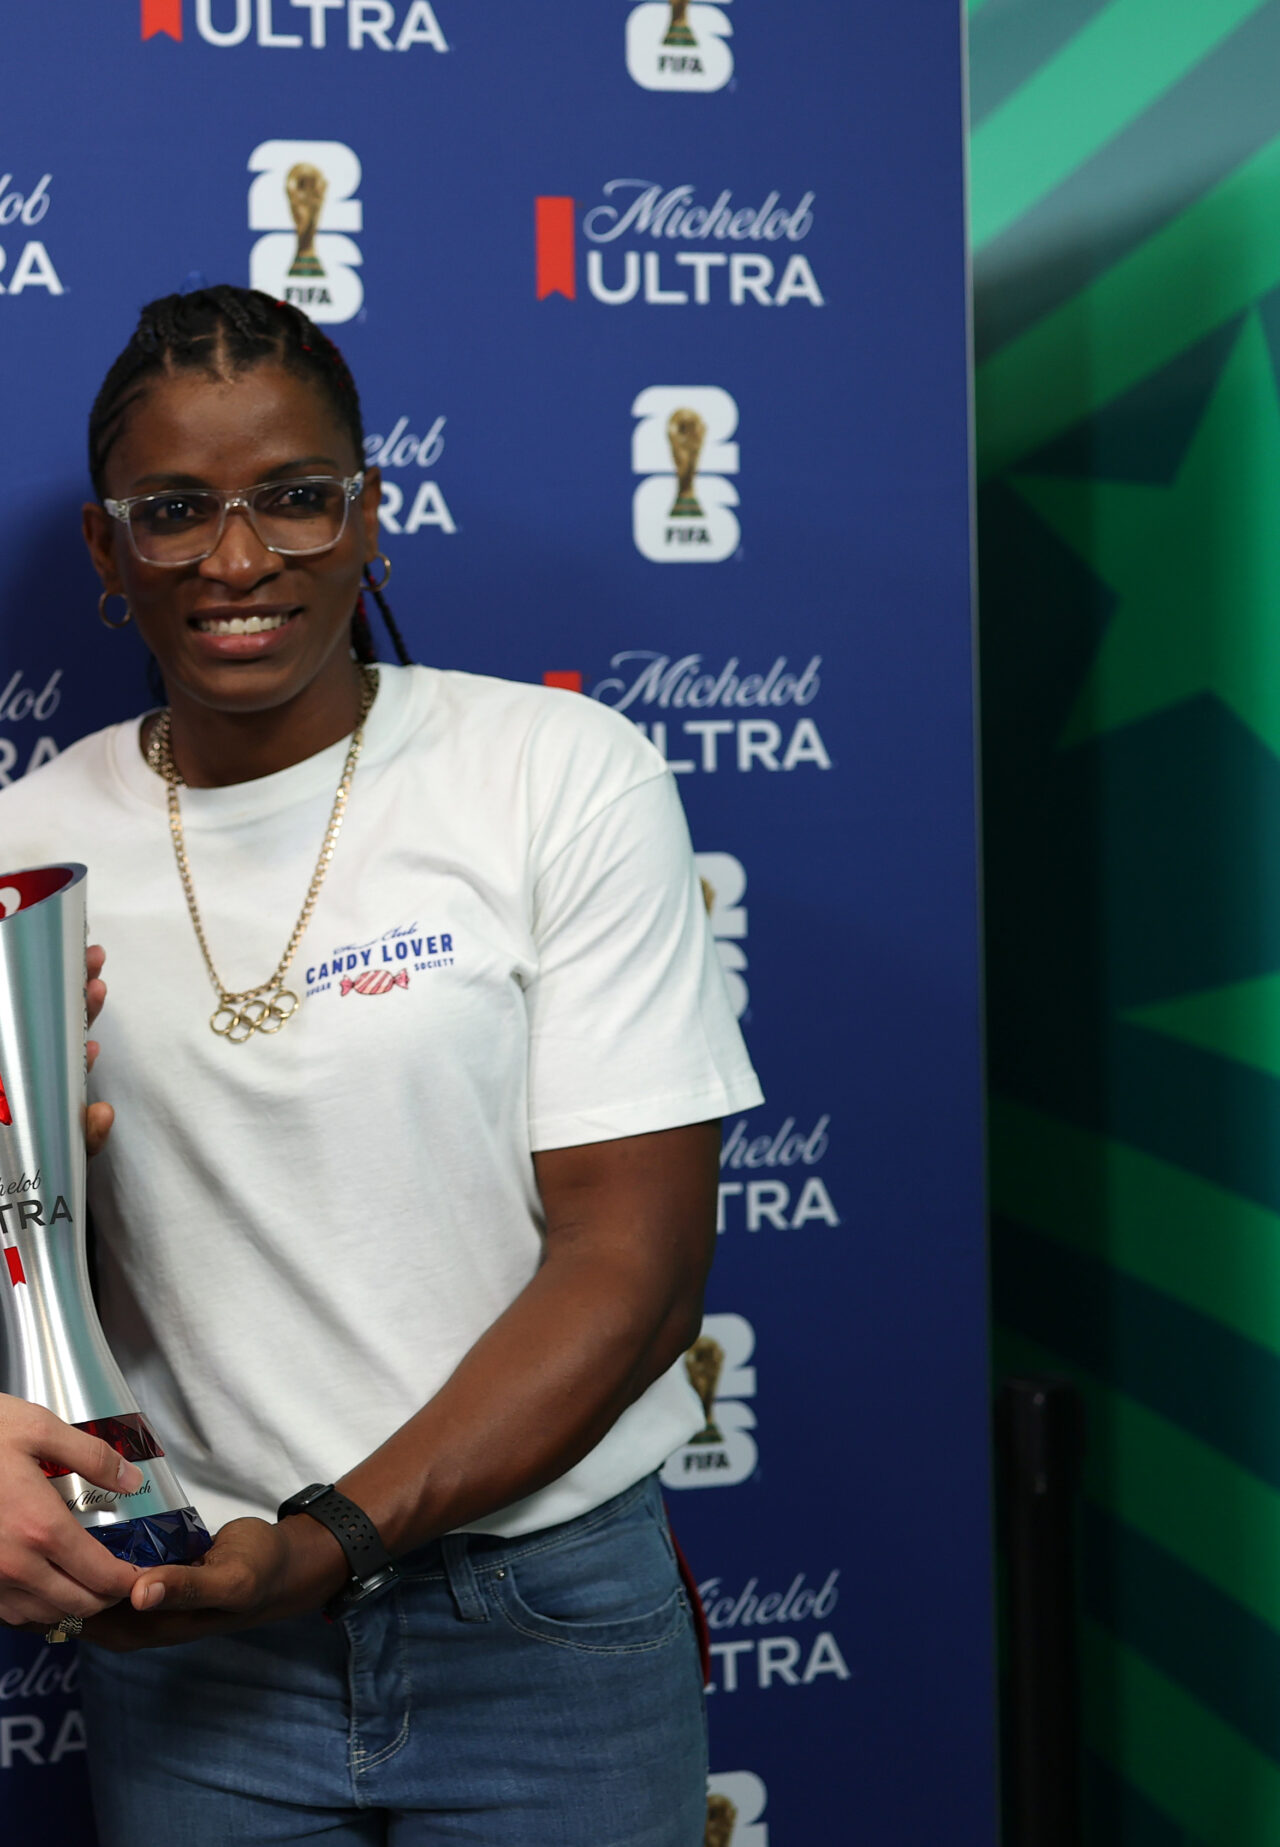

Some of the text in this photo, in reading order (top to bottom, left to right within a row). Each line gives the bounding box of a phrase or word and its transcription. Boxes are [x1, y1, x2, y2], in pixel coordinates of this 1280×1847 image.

[196, 0, 448, 52] ULTRA
[659, 56, 704, 74] FIFA
[583, 179, 814, 242] Michelob
[285, 287, 331, 305] FIFA
[587, 251, 823, 306] ULTRA
[665, 527, 711, 545] FIFA
[592, 650, 821, 711] Michelob
[636, 718, 831, 773] LTRA
[306, 949, 372, 984] CANDY
[382, 933, 453, 962] LOVER
[414, 958, 454, 971] SOCIETY
[720, 1113, 830, 1169] helob
[683, 1453, 730, 1472] FIFA
[698, 1570, 840, 1630] ichelob
